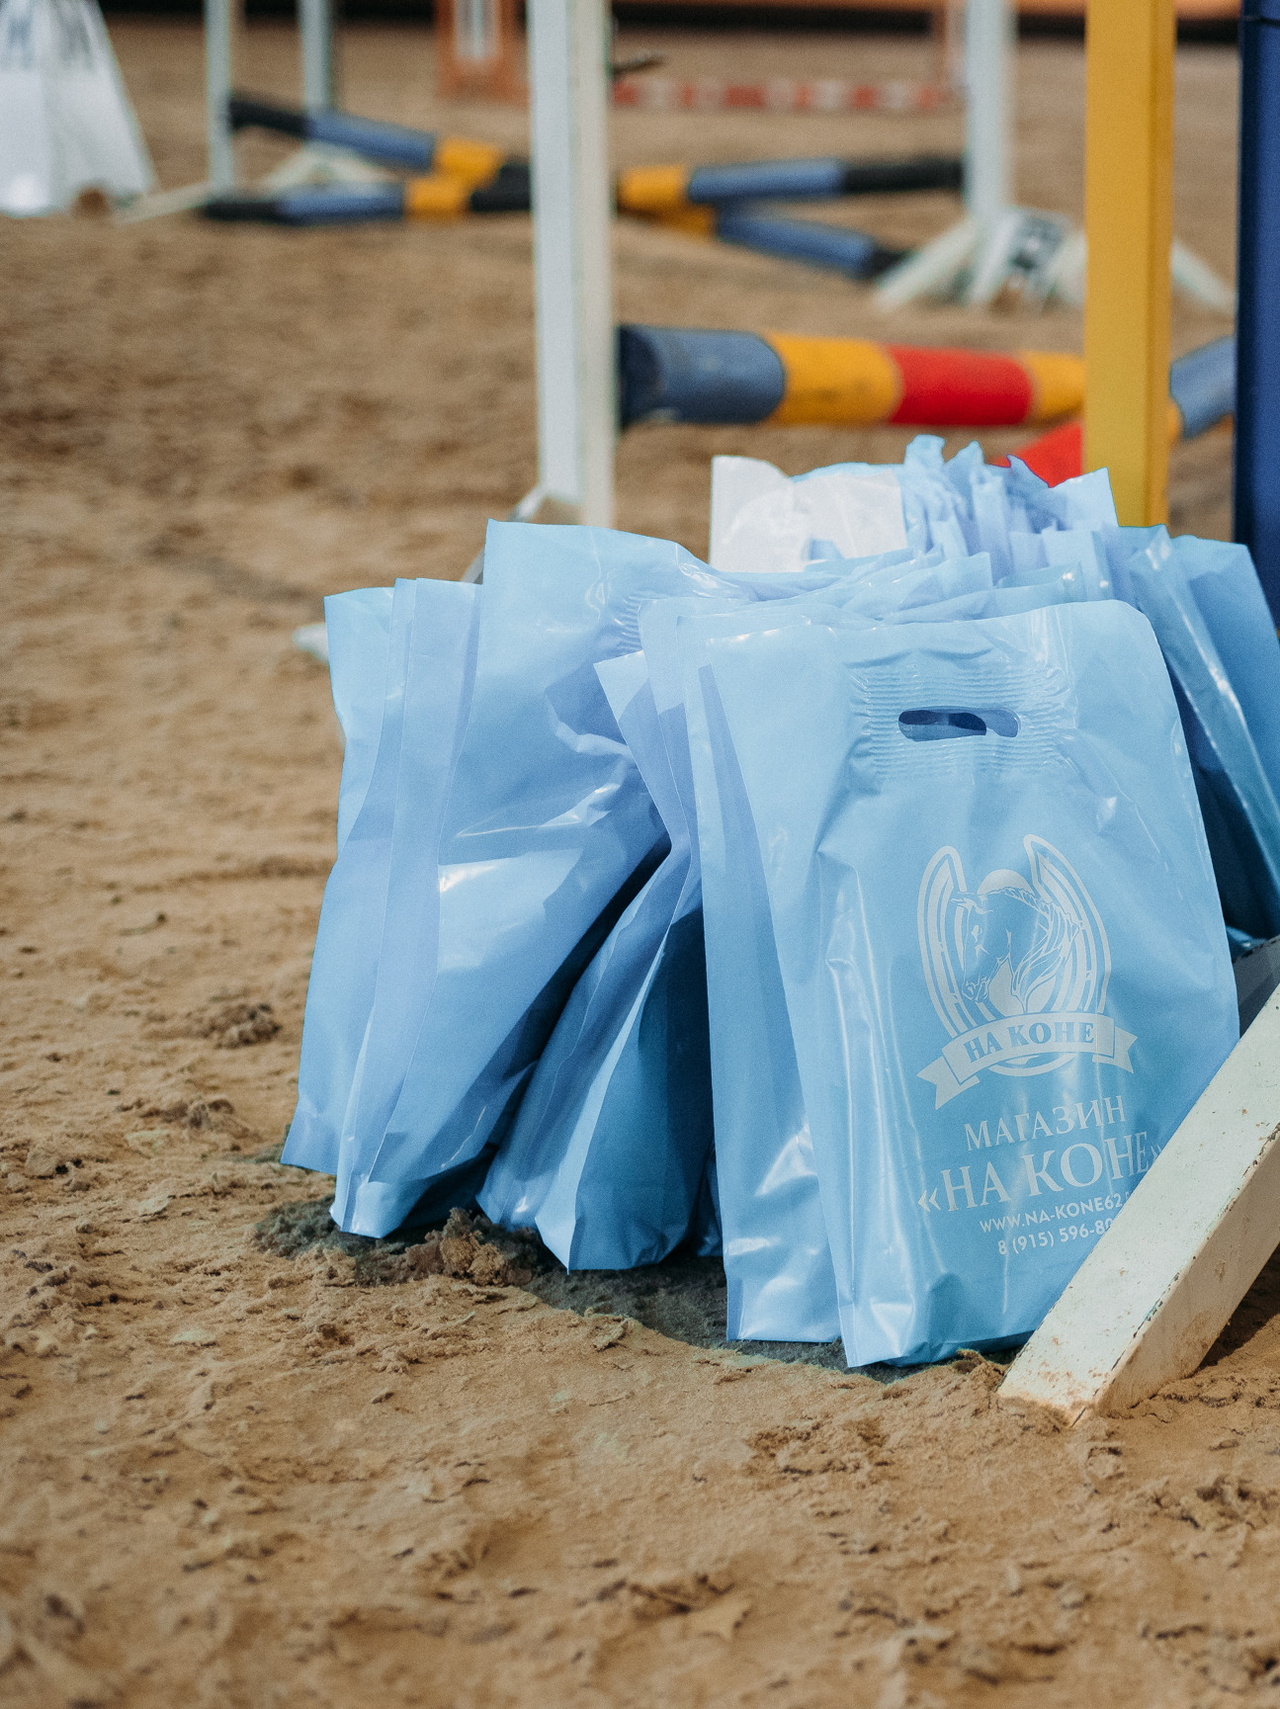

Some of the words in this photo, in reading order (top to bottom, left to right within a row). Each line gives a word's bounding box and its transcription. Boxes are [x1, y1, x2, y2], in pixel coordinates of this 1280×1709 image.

[963, 1031, 1003, 1063] НА
[1007, 1022, 1095, 1047] КОНЕ
[964, 1095, 1126, 1151] МАГАЗИН
[918, 1161, 1012, 1212] «НА
[979, 1192, 1129, 1233] WWW.NA-KONE62
[997, 1239, 1008, 1255] 8
[1012, 1230, 1055, 1254] (915)
